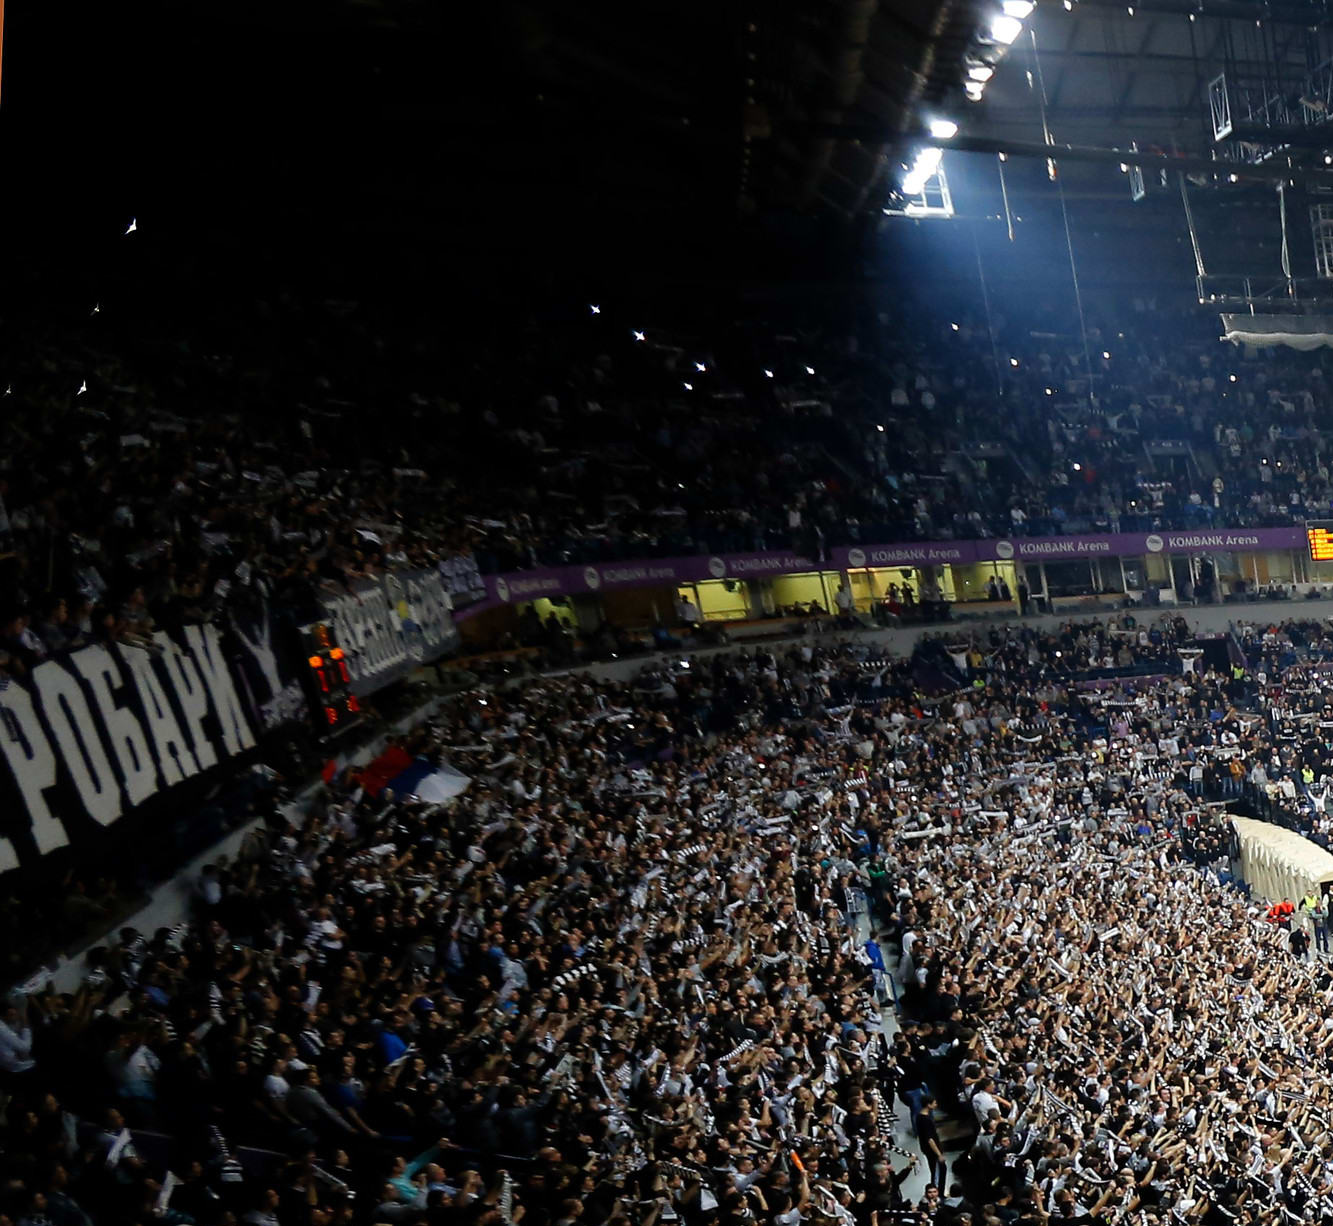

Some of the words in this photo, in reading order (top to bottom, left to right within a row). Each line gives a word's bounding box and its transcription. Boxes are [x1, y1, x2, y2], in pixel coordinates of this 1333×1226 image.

[1019, 542, 1074, 555] KOMBANK
[1077, 541, 1109, 553] Arena
[1169, 535, 1224, 548] KOMBANK
[1226, 534, 1258, 546] Arena
[871, 549, 926, 563] KOMBANK
[928, 548, 960, 560] Arena
[731, 557, 781, 572] KOMBANK
[0, 622, 257, 874] РОБАРИ
